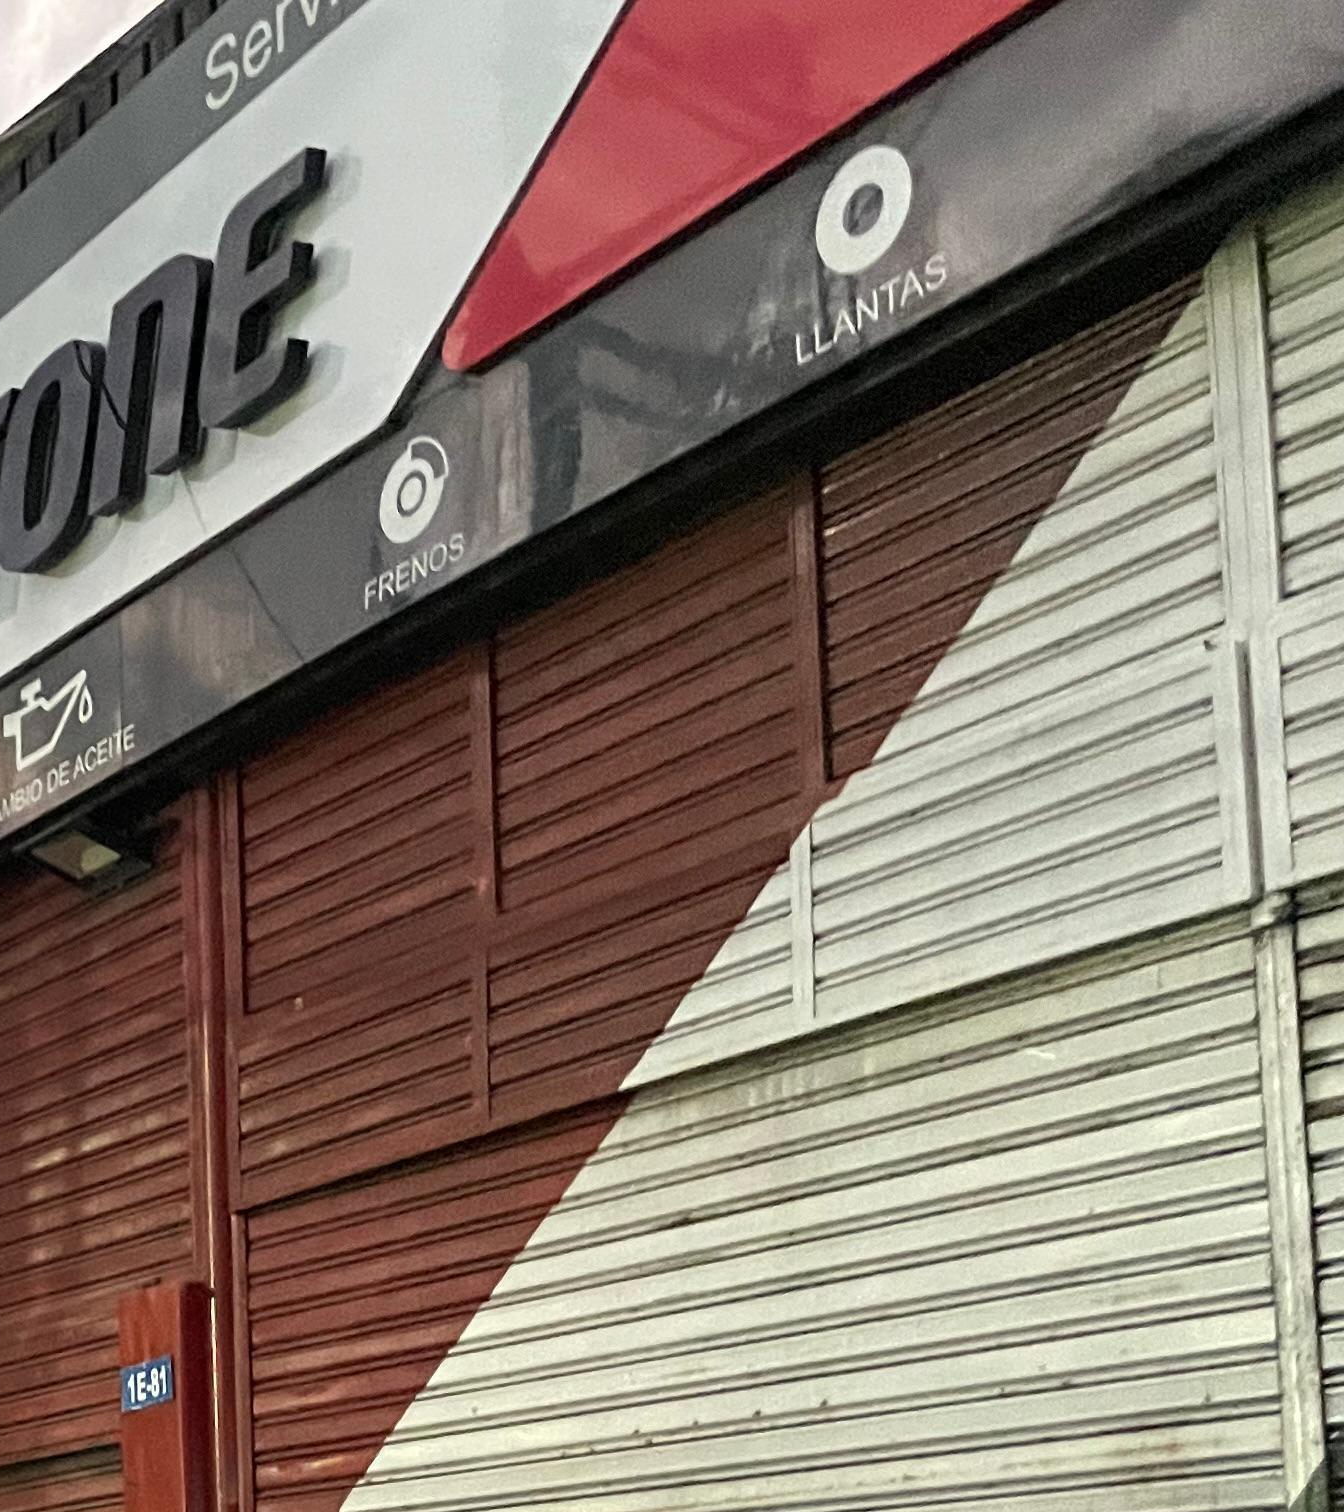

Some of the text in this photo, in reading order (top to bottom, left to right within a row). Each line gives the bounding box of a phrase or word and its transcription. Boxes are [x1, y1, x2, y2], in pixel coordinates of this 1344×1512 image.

[795, 254, 947, 365] LLANTAS
[364, 532, 464, 610] FRENOS
[46, 759, 70, 793] DE
[72, 723, 135, 779] ACEITE
[128, 1365, 167, 1403] 1E-81
